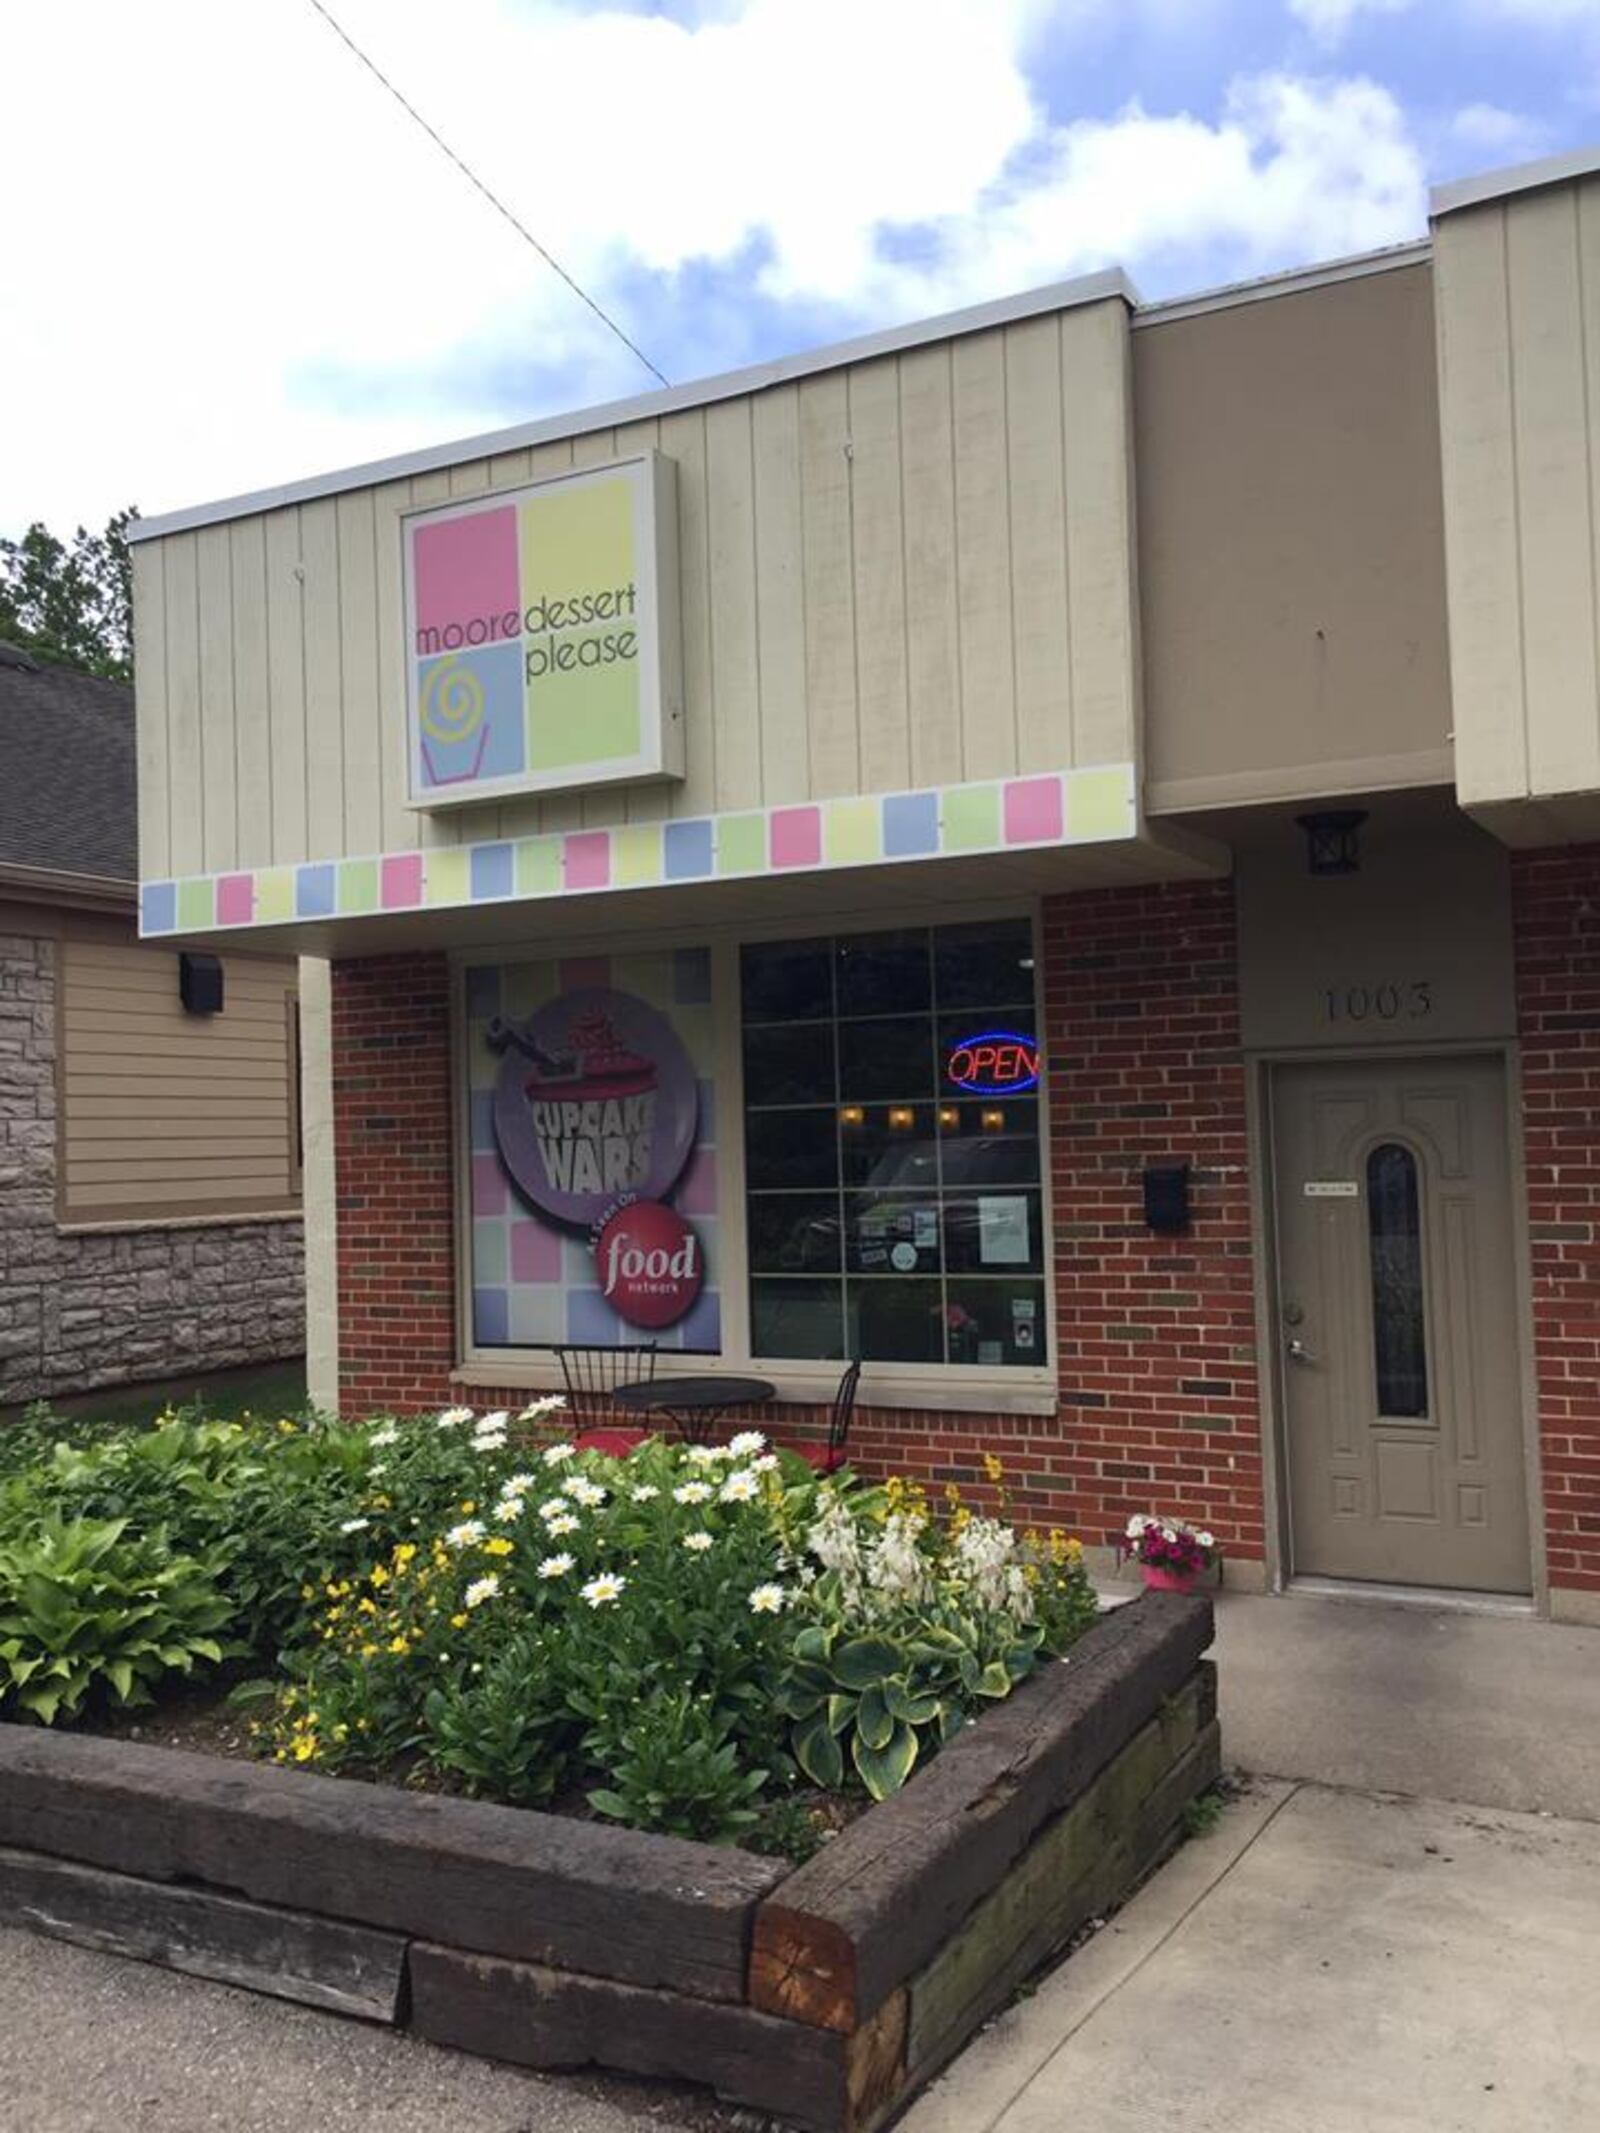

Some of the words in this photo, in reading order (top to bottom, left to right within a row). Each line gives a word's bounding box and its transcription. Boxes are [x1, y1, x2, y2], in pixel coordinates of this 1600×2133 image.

[417, 611, 521, 655] moore
[525, 584, 637, 634] dessert
[526, 631, 638, 686] please
[1324, 980, 1432, 1025] 1003
[947, 1045, 1040, 1083] OPEN
[532, 1095, 656, 1138] CUPCAKE
[536, 1132, 653, 1195] WARS
[603, 1232, 698, 1297] food
